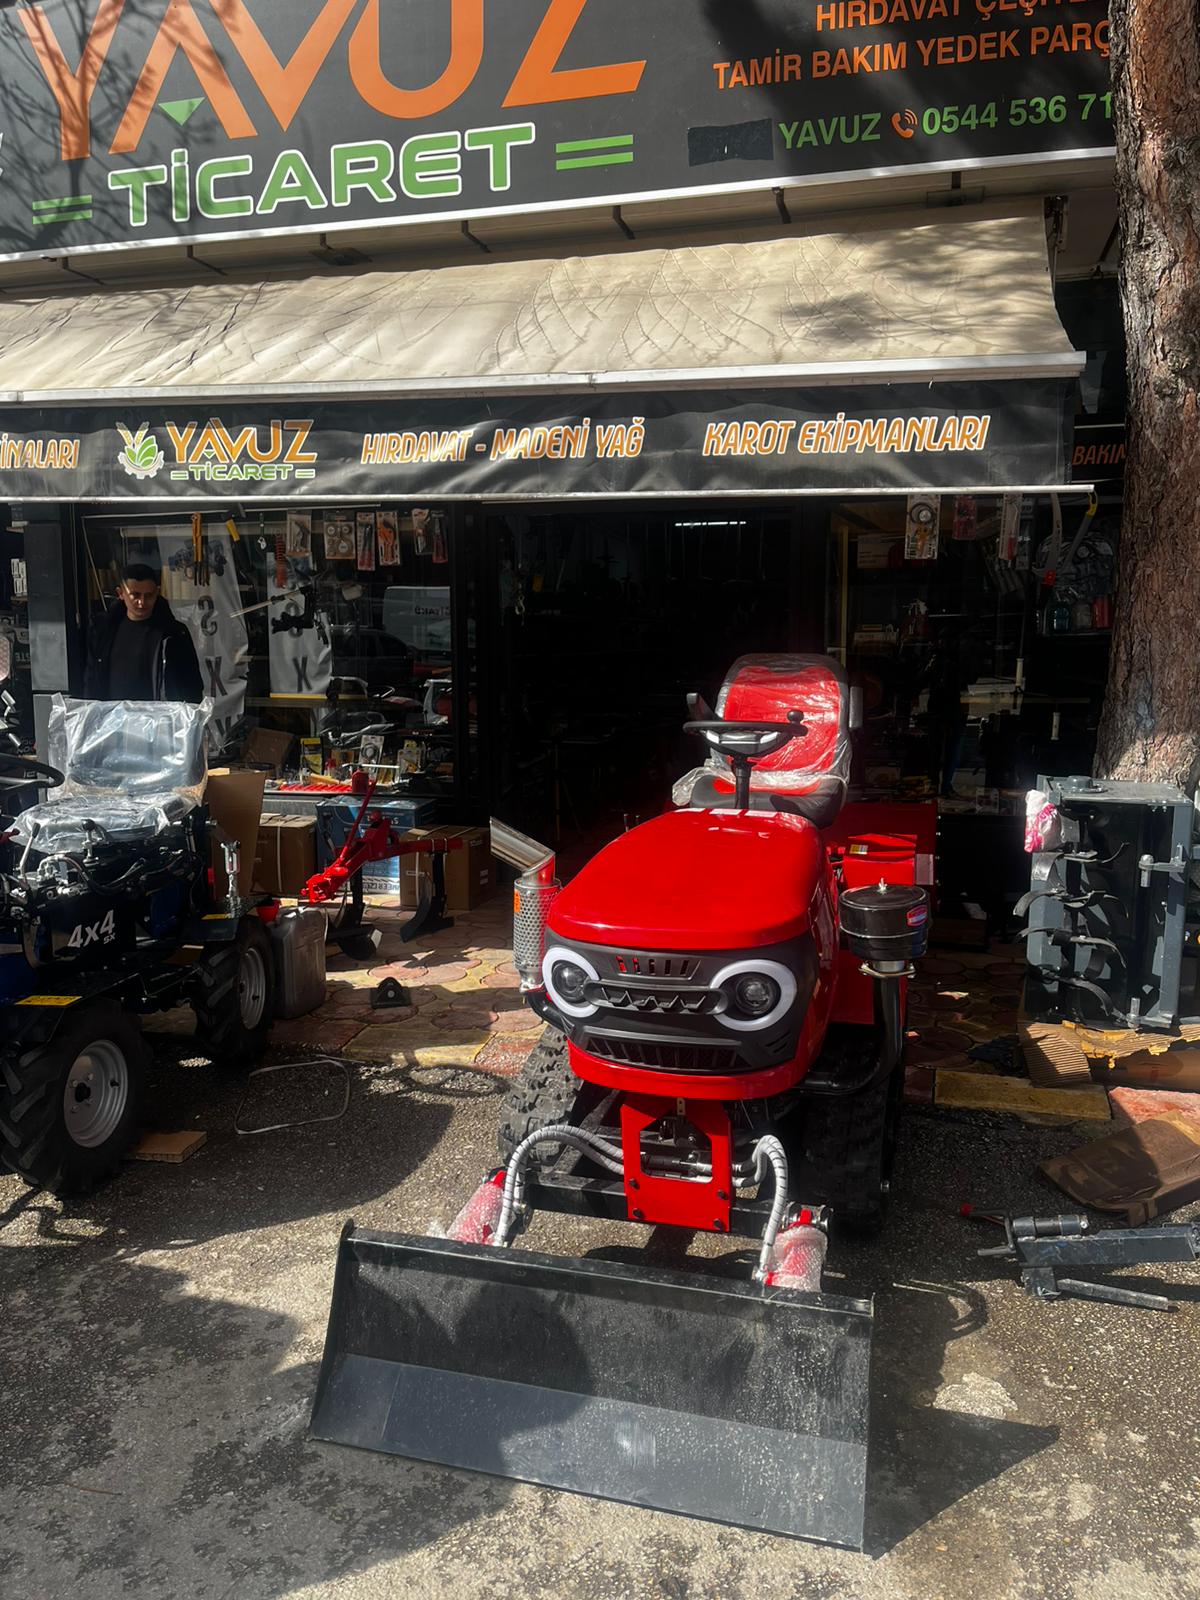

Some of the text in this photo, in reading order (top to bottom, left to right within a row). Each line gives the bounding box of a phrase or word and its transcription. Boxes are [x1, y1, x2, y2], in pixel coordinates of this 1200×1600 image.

[18, 0, 648, 161] YAVUZ
[711, 49, 802, 91] TAMİR
[811, 41, 907, 80] BAKIM
[916, 27, 1021, 68] YEDEK
[777, 91, 1113, 150] YAVUZ 0544 536 71
[107, 121, 537, 228] TİCARET
[0, 432, 81, 470] İNALARI
[165, 417, 319, 465] YAVUZ
[360, 430, 473, 465] HIRDAVAT
[490, 416, 592, 462] MADENİ
[593, 416, 647, 459] YAĞ
[701, 412, 992, 457] KAROT EKİPMANLARI
[187, 462, 291, 482] TİCARET
